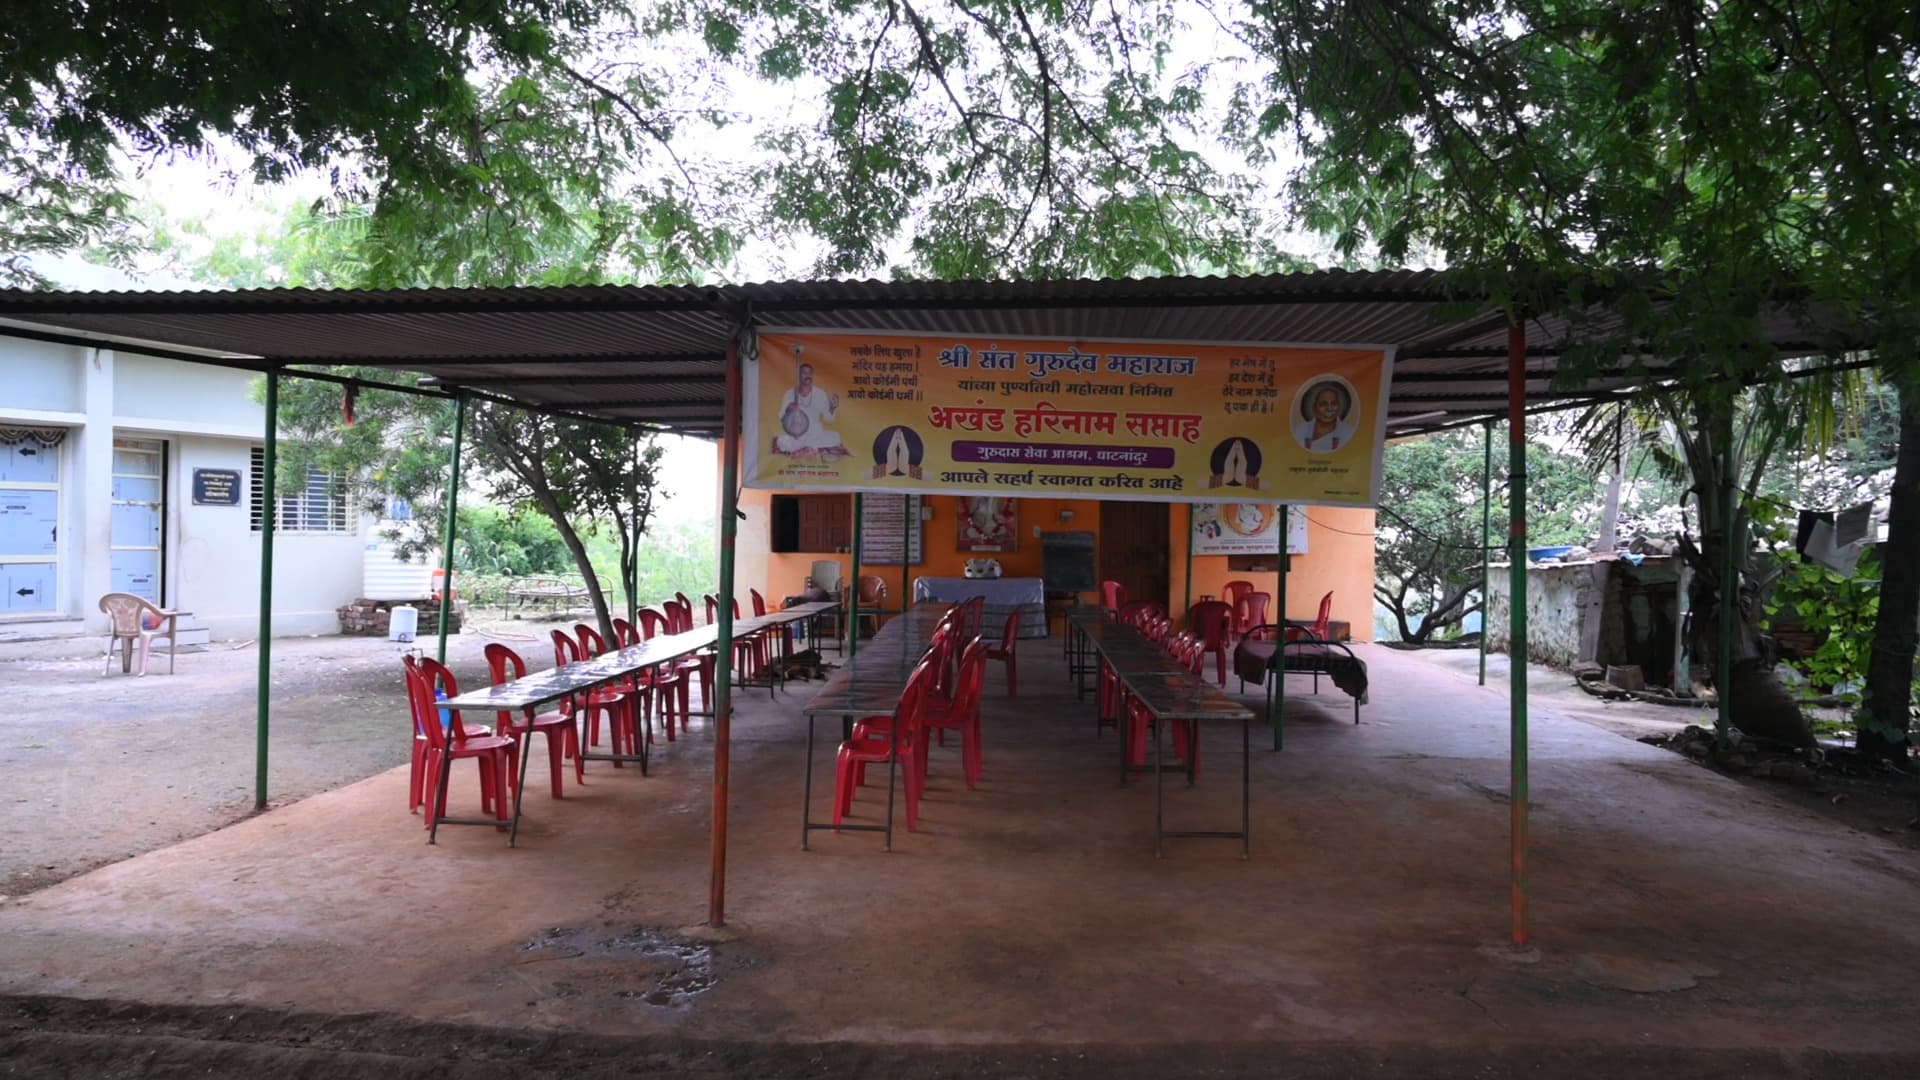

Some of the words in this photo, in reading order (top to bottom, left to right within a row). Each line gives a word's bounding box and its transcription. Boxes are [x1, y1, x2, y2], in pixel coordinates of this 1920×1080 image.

[939, 345, 970, 368] श्री
[978, 345, 1016, 369] संत
[1025, 347, 1099, 378] गुरुदेव
[1107, 353, 1197, 375] महाराज
[958, 377, 995, 392] यांच्या
[1000, 380, 1060, 395] पुण्यतिथी
[928, 398, 1005, 432] अखंड
[1014, 401, 1117, 437] हरिनाम
[1126, 412, 1202, 444] सप्ताह
[978, 446, 1020, 460] गुरुदास
[1023, 446, 1047, 459] सेवा
[940, 468, 988, 483] आपले
[994, 470, 1034, 486] सहर्ष
[1038, 473, 1093, 486] स्वागत
[1099, 473, 1144, 488] करित
[1149, 474, 1184, 490] आहे
